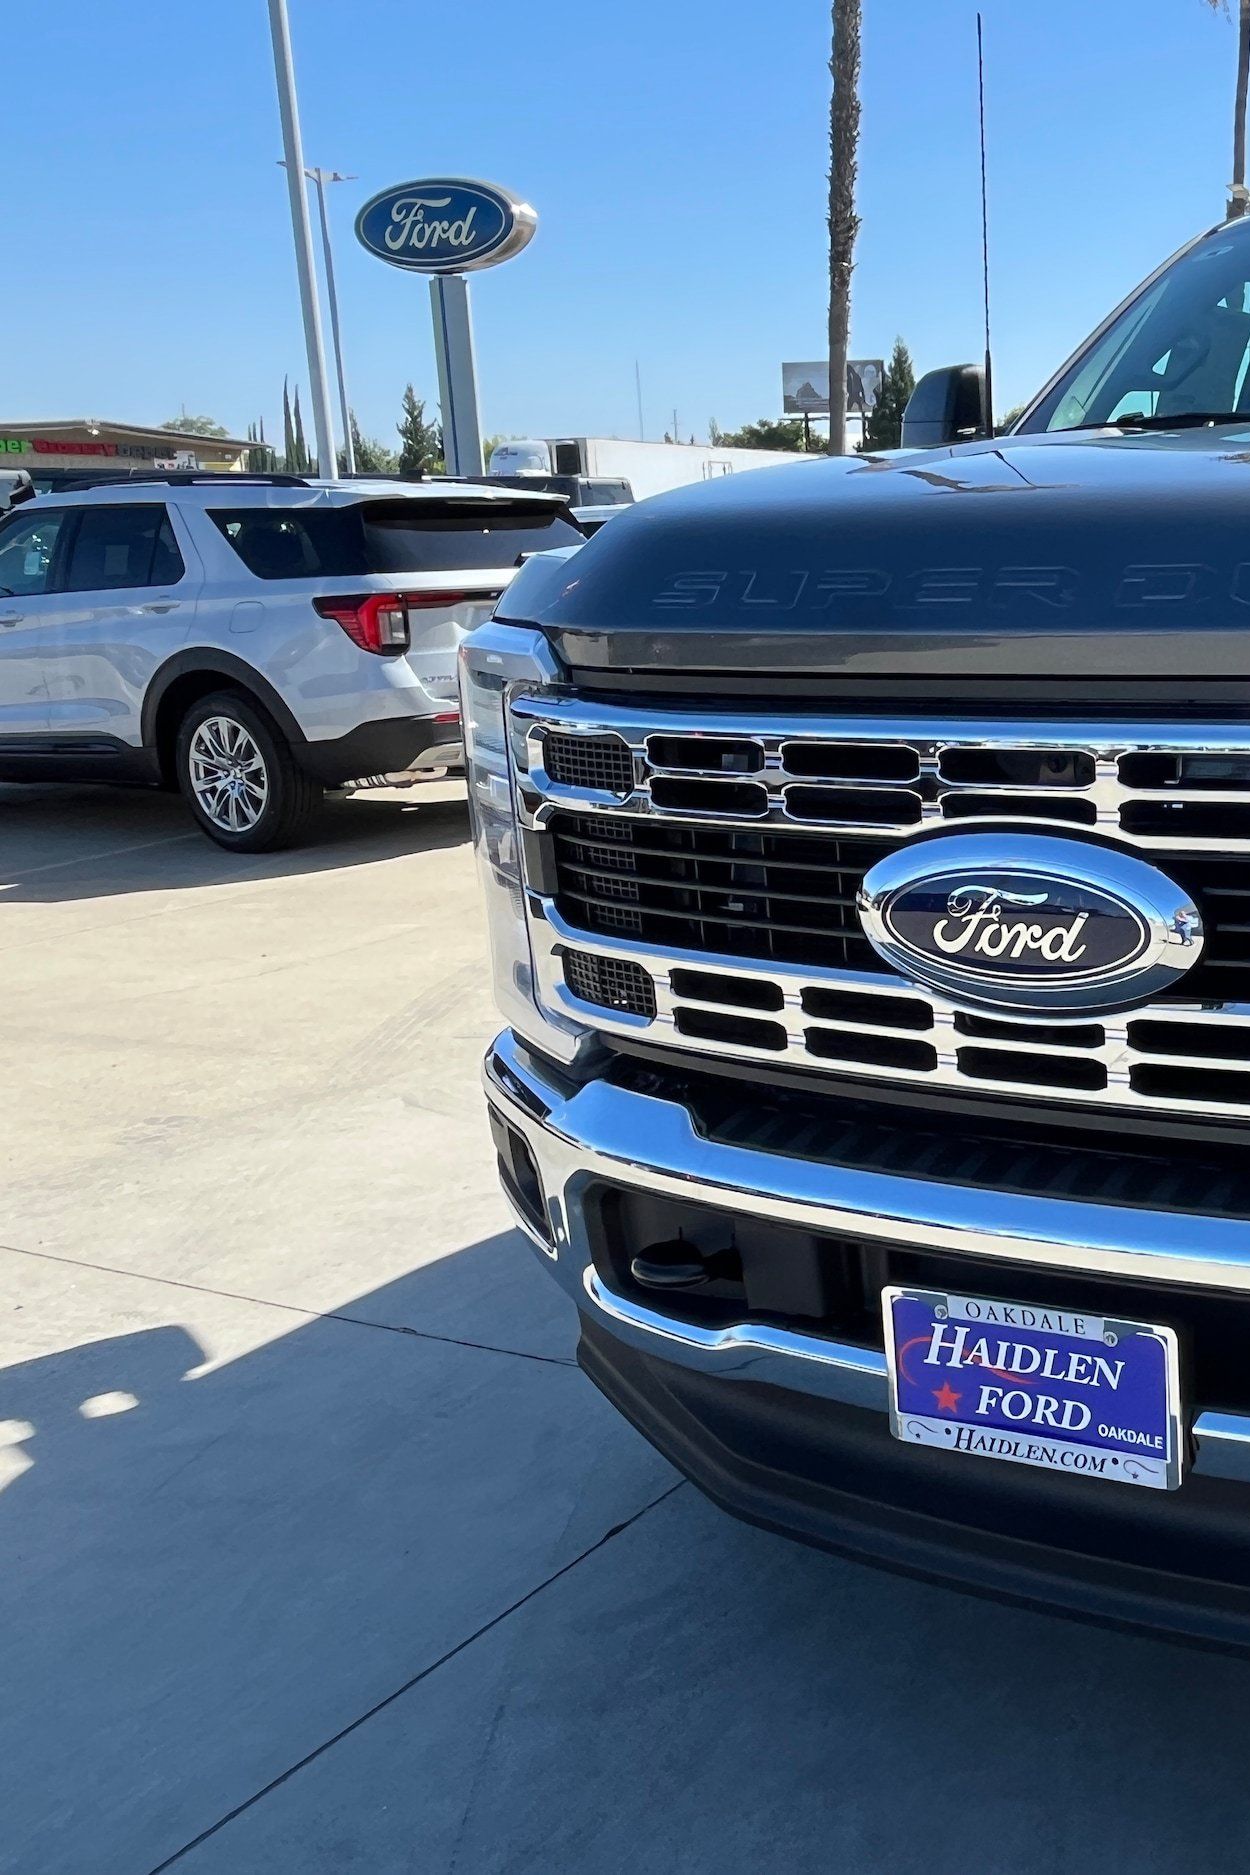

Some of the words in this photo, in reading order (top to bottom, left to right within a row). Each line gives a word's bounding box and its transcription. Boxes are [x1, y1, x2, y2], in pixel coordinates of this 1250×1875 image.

[385, 197, 477, 250] Ford
[651, 566, 1081, 609] SUPER
[933, 884, 1090, 963] Ford
[965, 1301, 1087, 1336] OAKDALE
[975, 1384, 1092, 1432] FORD
[1097, 1423, 1164, 1450] OAKDALE
